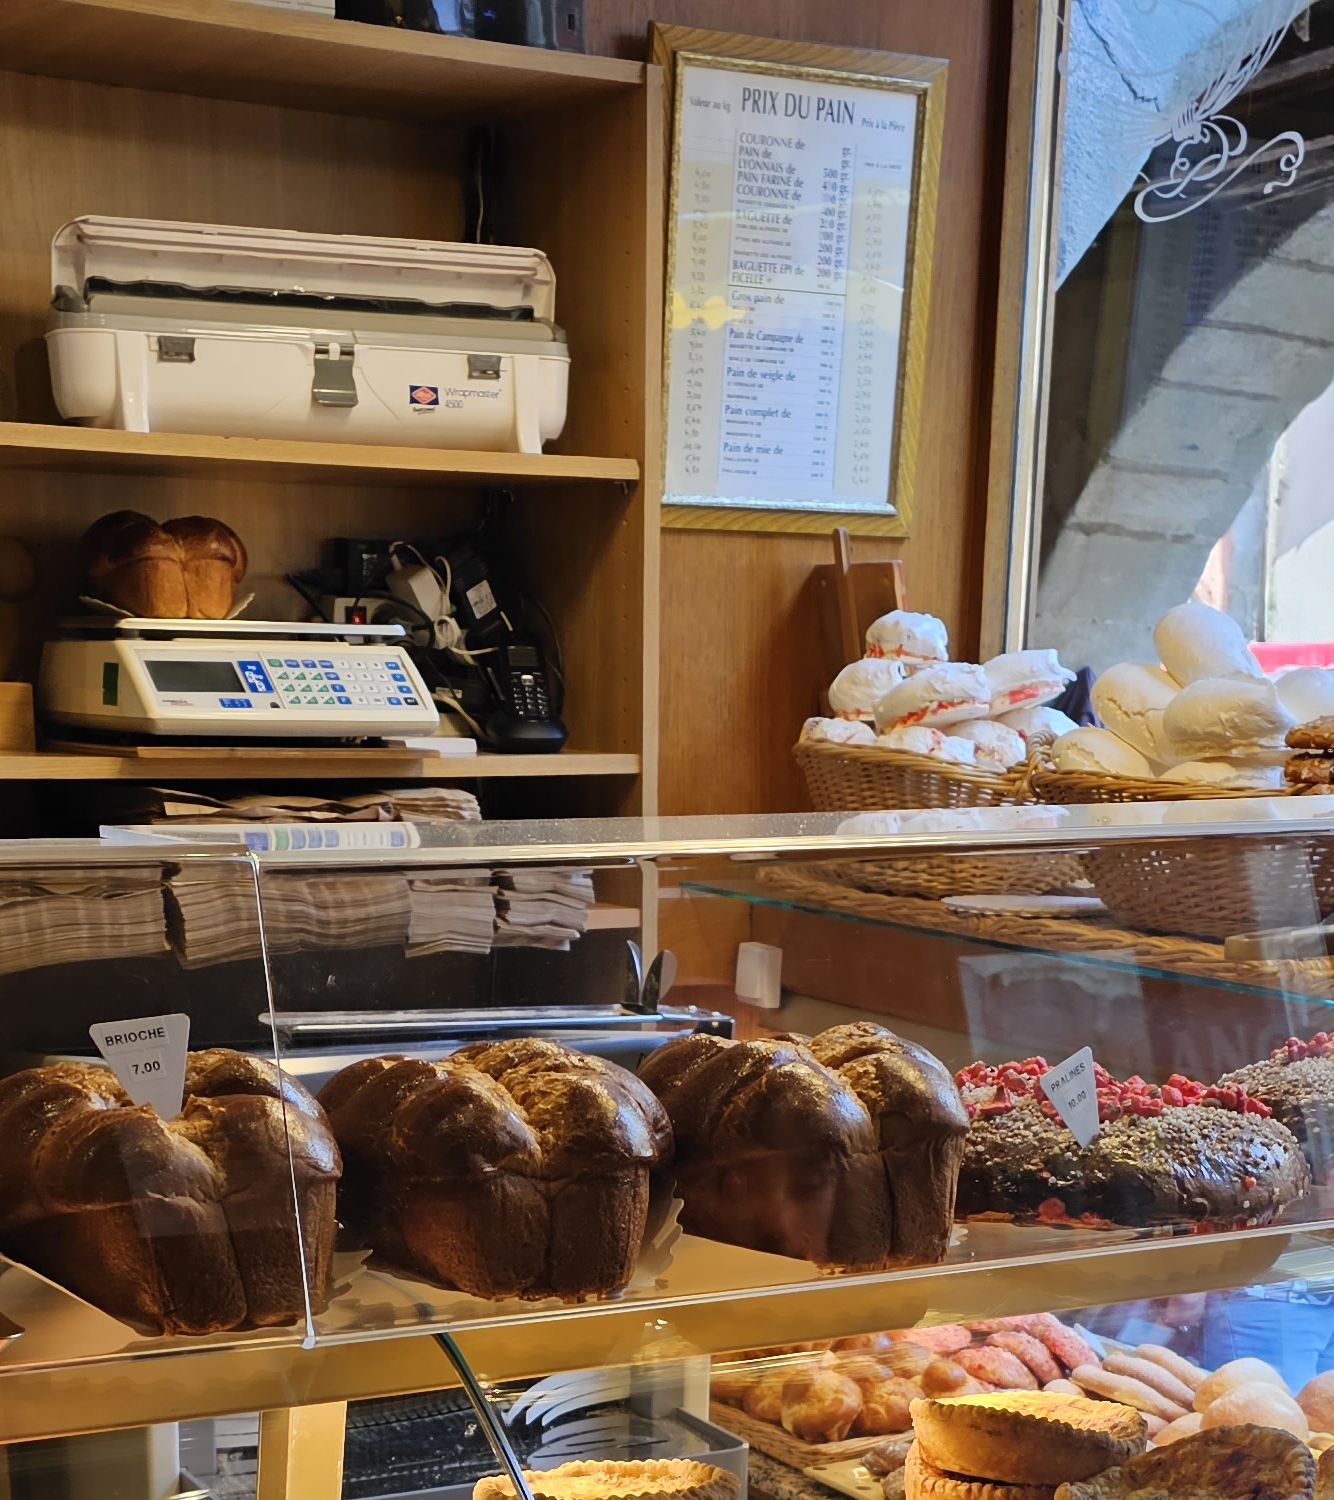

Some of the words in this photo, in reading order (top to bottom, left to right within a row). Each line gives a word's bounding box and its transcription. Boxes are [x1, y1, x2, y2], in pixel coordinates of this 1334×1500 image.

[741, 87, 779, 116] PRIX
[784, 92, 811, 120] DU
[816, 96, 855, 125] PAIN
[739, 132, 793, 149] COURONNE
[794, 138, 805, 150] de
[738, 144, 760, 158] PAIN
[762, 147, 773, 159] de
[738, 158, 784, 173] LYONNAIS
[786, 163, 796, 175] de
[737, 170, 759, 183] PAIN
[793, 176, 804, 188] de
[736, 183, 790, 200] COURONNE
[791, 189, 802, 201] de
[735, 208, 780, 225] BAGUETTE
[782, 213, 793, 225] de
[732, 259, 778, 274] BAGUETTE
[731, 272, 764, 285] FICELLE
[731, 290, 752, 302] Gros
[753, 293, 772, 304] pain
[774, 293, 785, 304] de
[728, 327, 745, 339] Pain
[756, 330, 794, 344] Campagne
[727, 366, 745, 378] Pain
[747, 368, 757, 379] de
[785, 370, 796, 381] de
[724, 404, 743, 416] Pain
[745, 406, 779, 420] complet
[781, 408, 791, 419] de
[723, 441, 741, 453] Pain
[743, 443, 754, 454] de
[773, 444, 784, 455] de
[105, 1027, 166, 1048] BRIOCHE
[1050, 1062, 1086, 1093] PRALINES
